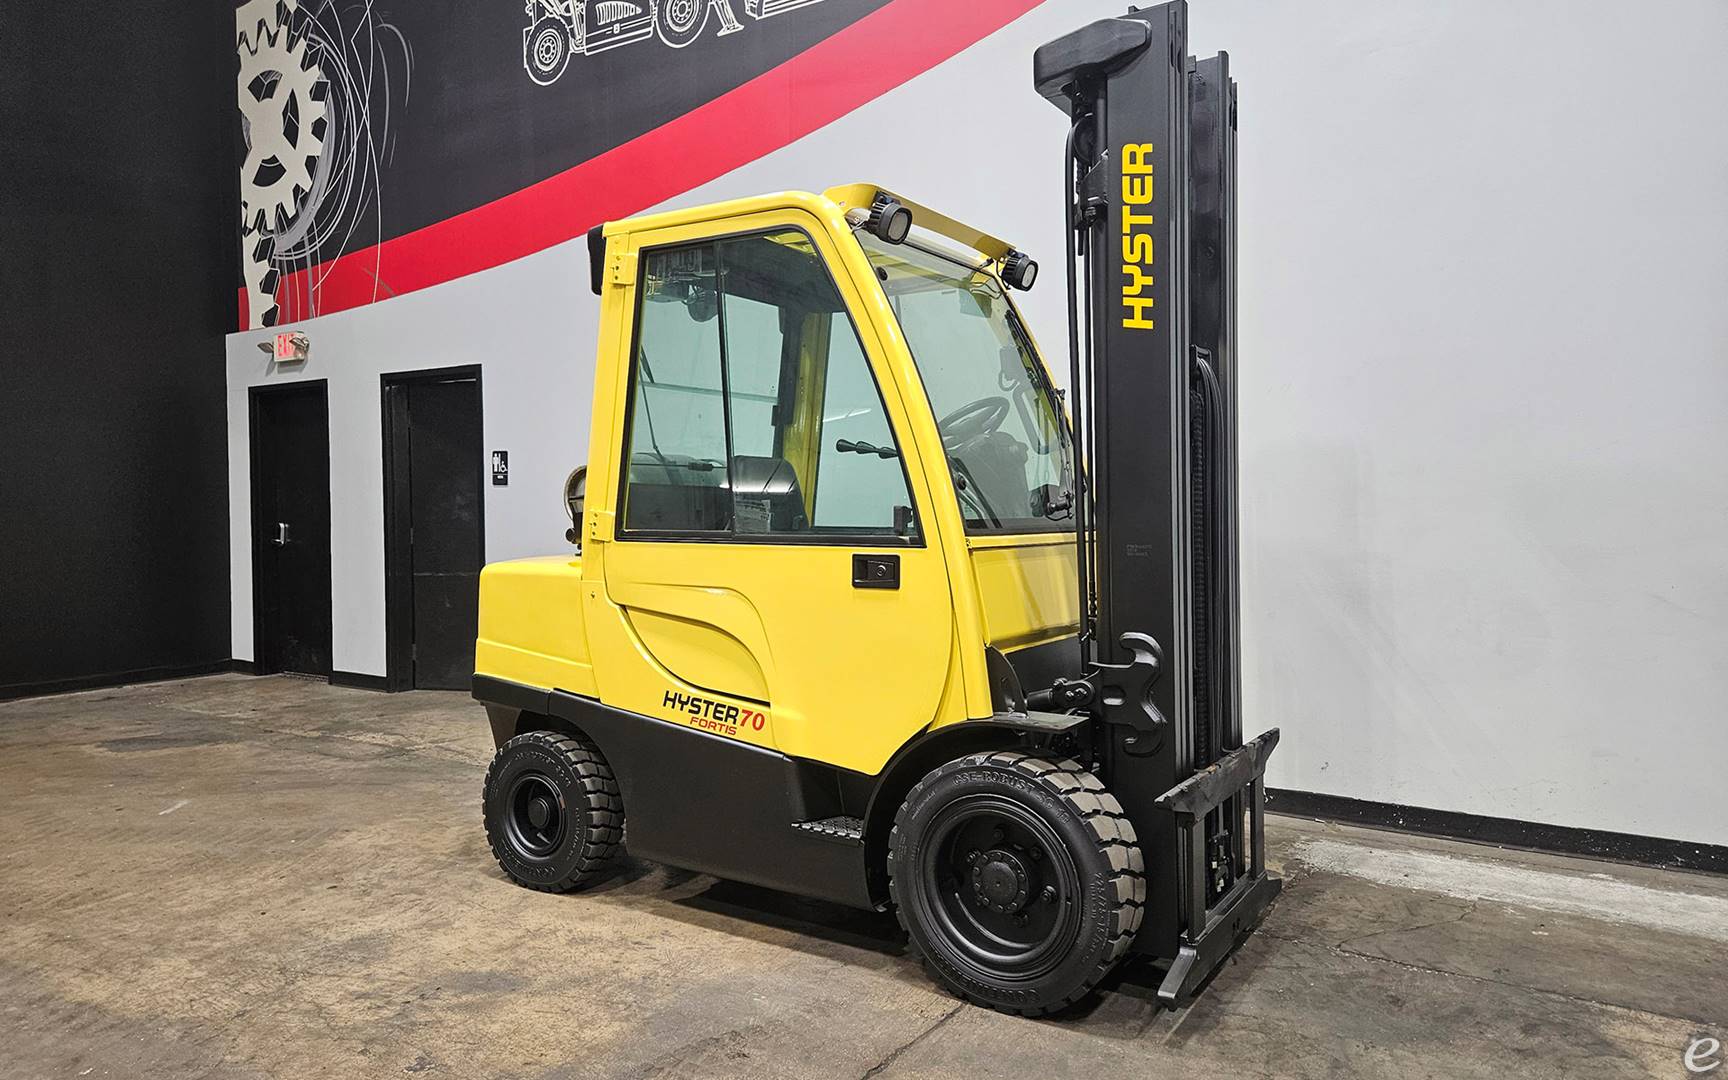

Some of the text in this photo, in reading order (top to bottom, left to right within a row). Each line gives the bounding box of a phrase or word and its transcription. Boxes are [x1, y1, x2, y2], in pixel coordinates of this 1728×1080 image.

[1121, 143, 1154, 330] HYSTER
[663, 690, 766, 731] HYSTER 70
[690, 717, 738, 736] FORTIS
